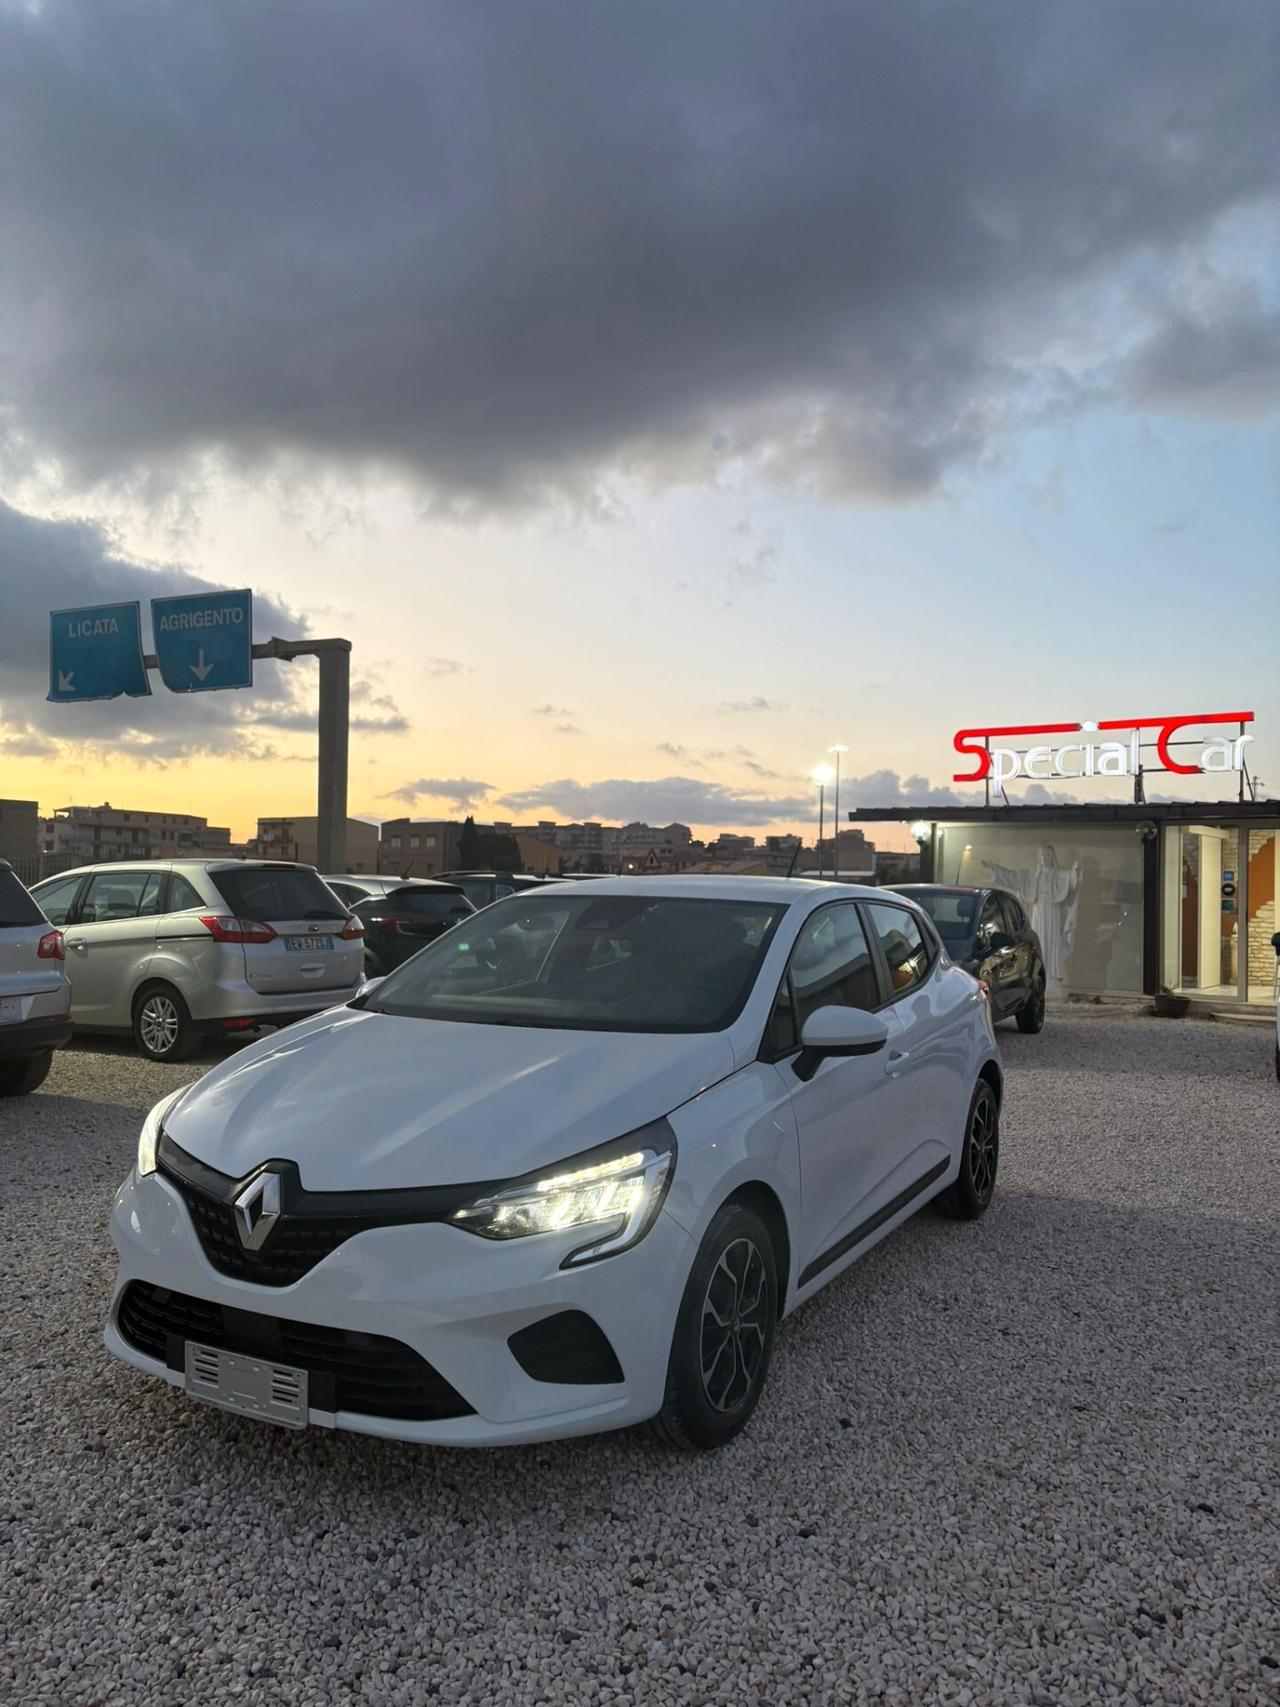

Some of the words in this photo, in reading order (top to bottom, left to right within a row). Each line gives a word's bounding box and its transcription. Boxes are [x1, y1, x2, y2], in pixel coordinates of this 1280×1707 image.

[68, 617, 119, 638] LICATA
[160, 607, 244, 631] AGRIGENTO
[953, 720, 1140, 798] Special
[1157, 711, 1255, 775] Car
